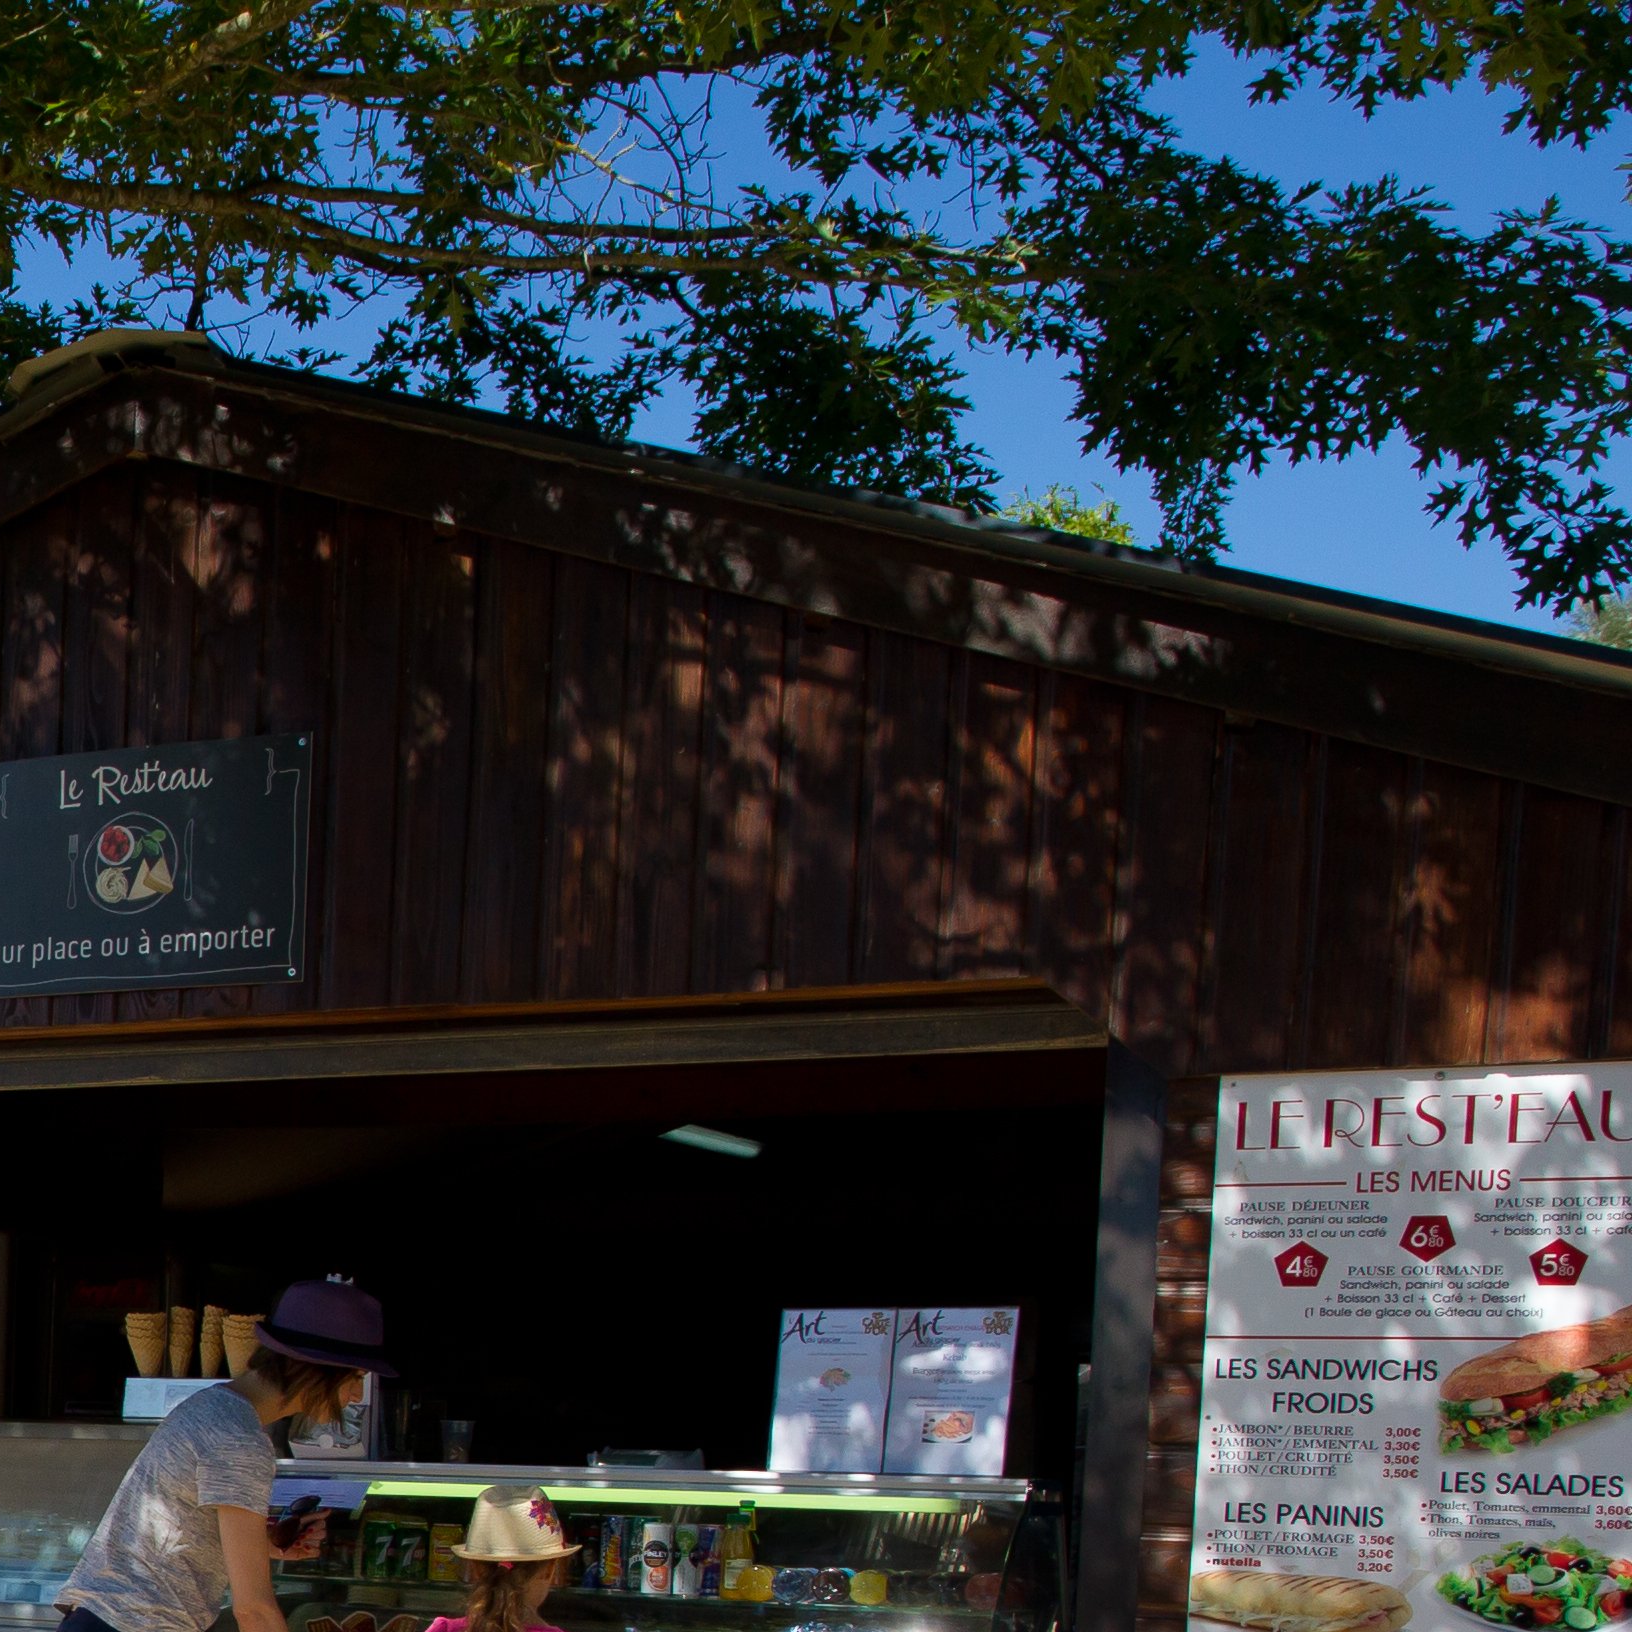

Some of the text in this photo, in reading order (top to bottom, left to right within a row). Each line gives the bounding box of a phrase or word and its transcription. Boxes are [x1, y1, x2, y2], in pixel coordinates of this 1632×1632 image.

[59, 769, 84, 810] Le
[32, 936, 93, 969] place
[101, 938, 129, 957] ou
[138, 929, 151, 955] à
[159, 924, 276, 959] emporter
[1237, 1090, 1632, 1150] LE REST'EAU
[1357, 1169, 1511, 1193] LES MENUS
[1240, 1200, 1369, 1212] PAUSE DÉJEUNER
[1495, 1196, 1632, 1208] PAUSE DOUCEUR
[1224, 1217, 1283, 1226] Sandwich,
[1287, 1216, 1325, 1226] panini
[1346, 1216, 1387, 1224] salade
[1474, 1212, 1603, 1223] Sandwich, panini ou
[1242, 1230, 1285, 1239] boisson
[1288, 1230, 1303, 1238] 33
[1306, 1230, 1317, 1238] cl
[1358, 1229, 1386, 1238] café
[1504, 1226, 1550, 1236] boisson
[1555, 1226, 1571, 1236] 33
[1574, 1226, 1586, 1236] cl
[1592, 1227, 1601, 1235] +
[1348, 1265, 1503, 1276] PAUSE GOURMANDE
[1340, 1280, 1509, 1291] Sandwich, panini ou salade
[1337, 1294, 1380, 1303] Boisson
[1384, 1294, 1399, 1303] 33
[1402, 1294, 1413, 1303] cl
[1432, 1293, 1463, 1303] Café
[1482, 1294, 1526, 1304] Dessert
[1320, 1308, 1352, 1317] Boule
[1355, 1308, 1372, 1316] de
[1375, 1308, 1411, 1319] glace
[1415, 1309, 1430, 1317] ou
[1434, 1307, 1482, 1317] Gâteau
[1486, 1309, 1502, 1317] au
[1506, 1307, 1543, 1318] choix)
[1215, 1359, 1438, 1381] LES SANDWICHS
[1272, 1392, 1373, 1414] FROIDS
[1386, 1428, 1421, 1438] 3,00€
[1385, 1441, 1420, 1452] 3,30€
[1384, 1455, 1419, 1465] 3,50€
[1382, 1469, 1419, 1479] 3,50€
[1441, 1472, 1624, 1497] LES SALADES
[1429, 1501, 1632, 1515] Poulet, Tomates, emmental 3,60€
[1224, 1502, 1384, 1528] LES PANINIS
[1429, 1513, 1463, 1525] Thon,
[1467, 1515, 1521, 1526] Tomates,
[1595, 1519, 1632, 1530] 3,60€
[1429, 1529, 1500, 1539] olives noires
[1359, 1535, 1395, 1545] 3,50€
[1358, 1549, 1394, 1559] 3,50€
[1212, 1557, 1393, 1572] nutella 3,20€
